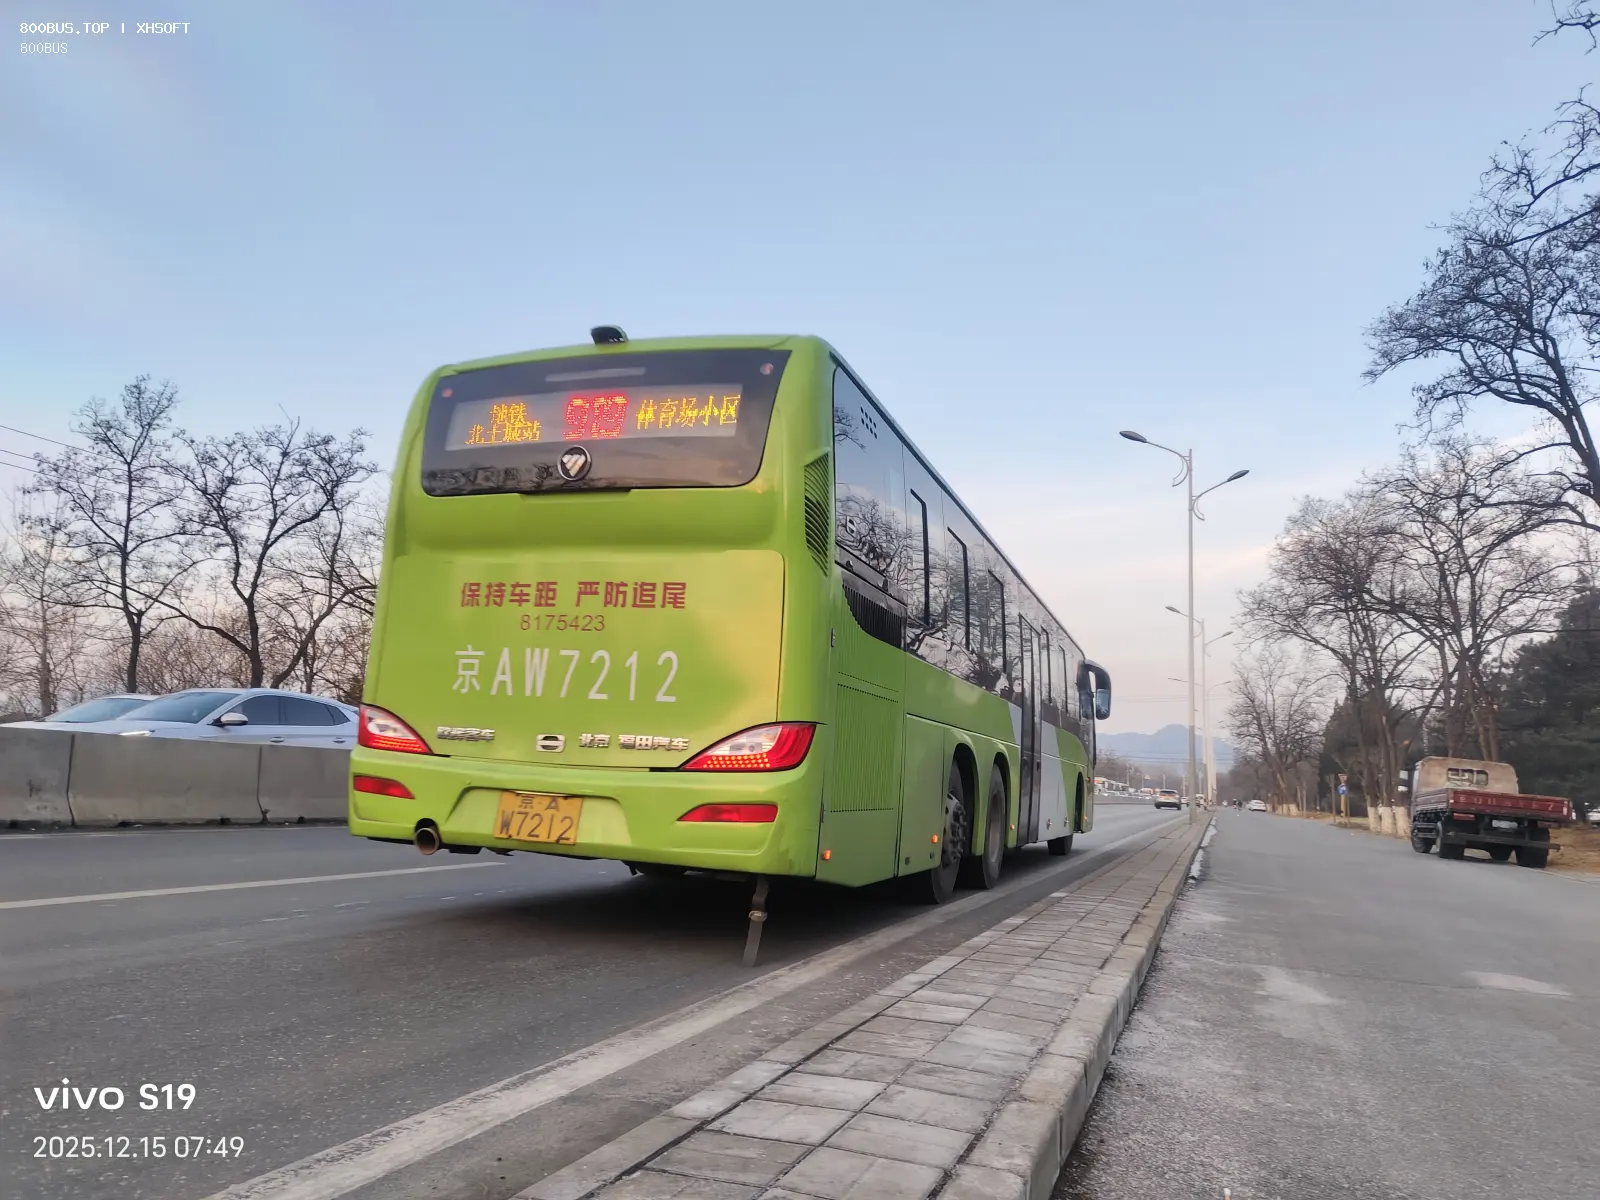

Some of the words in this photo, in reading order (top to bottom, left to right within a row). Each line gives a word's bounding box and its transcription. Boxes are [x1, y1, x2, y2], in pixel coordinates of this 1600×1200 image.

[562, 395, 628, 440] 919
[636, 394, 741, 430] 体育场小区
[461, 581, 558, 608] 保持车距
[575, 581, 687, 610] 严防追尾
[520, 614, 606, 632] 8175423
[452, 644, 679, 703] 京AW7212
[579, 732, 611, 749] 北京
[499, 810, 574, 843] W7212
